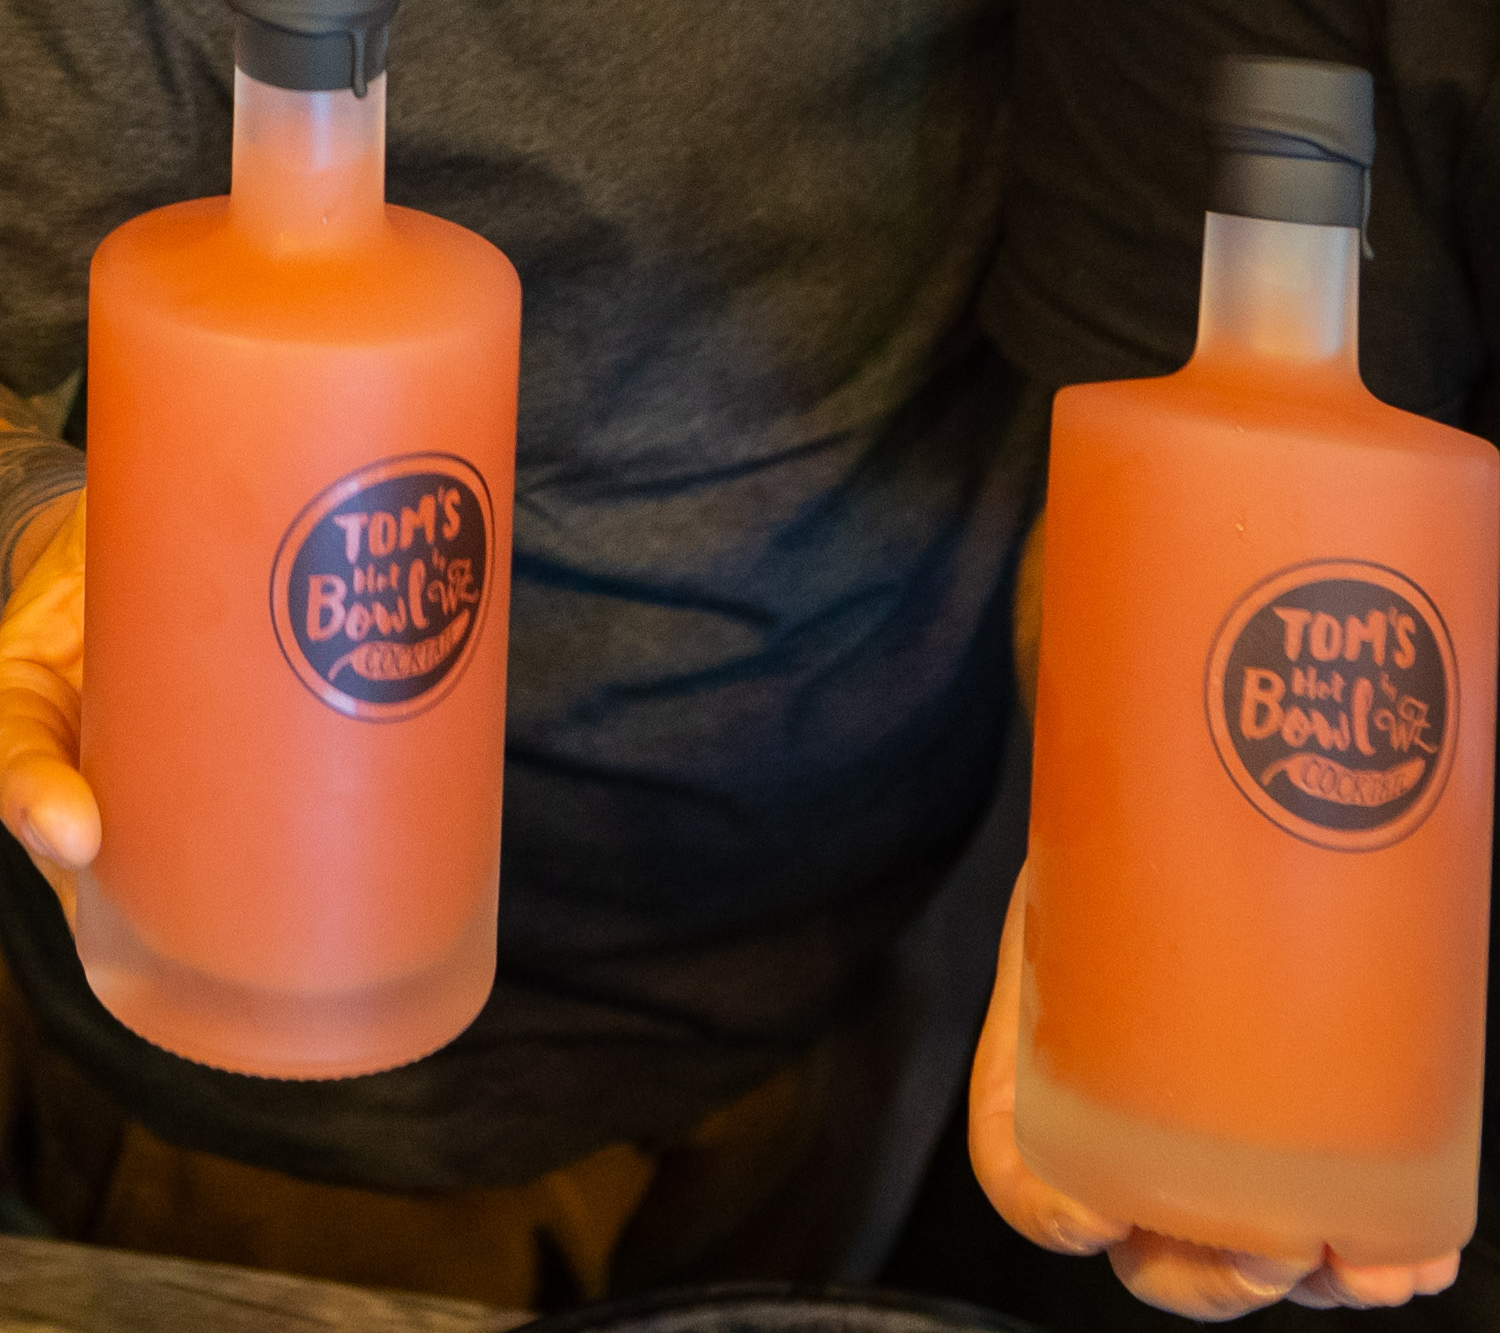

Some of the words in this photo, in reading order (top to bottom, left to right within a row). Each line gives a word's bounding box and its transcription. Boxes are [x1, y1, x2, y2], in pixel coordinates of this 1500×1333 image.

[333, 486, 461, 564] TOM'S
[306, 558, 429, 641] Bowl
[1273, 605, 1416, 669] TOM'S
[1240, 666, 1376, 756] Bowl
